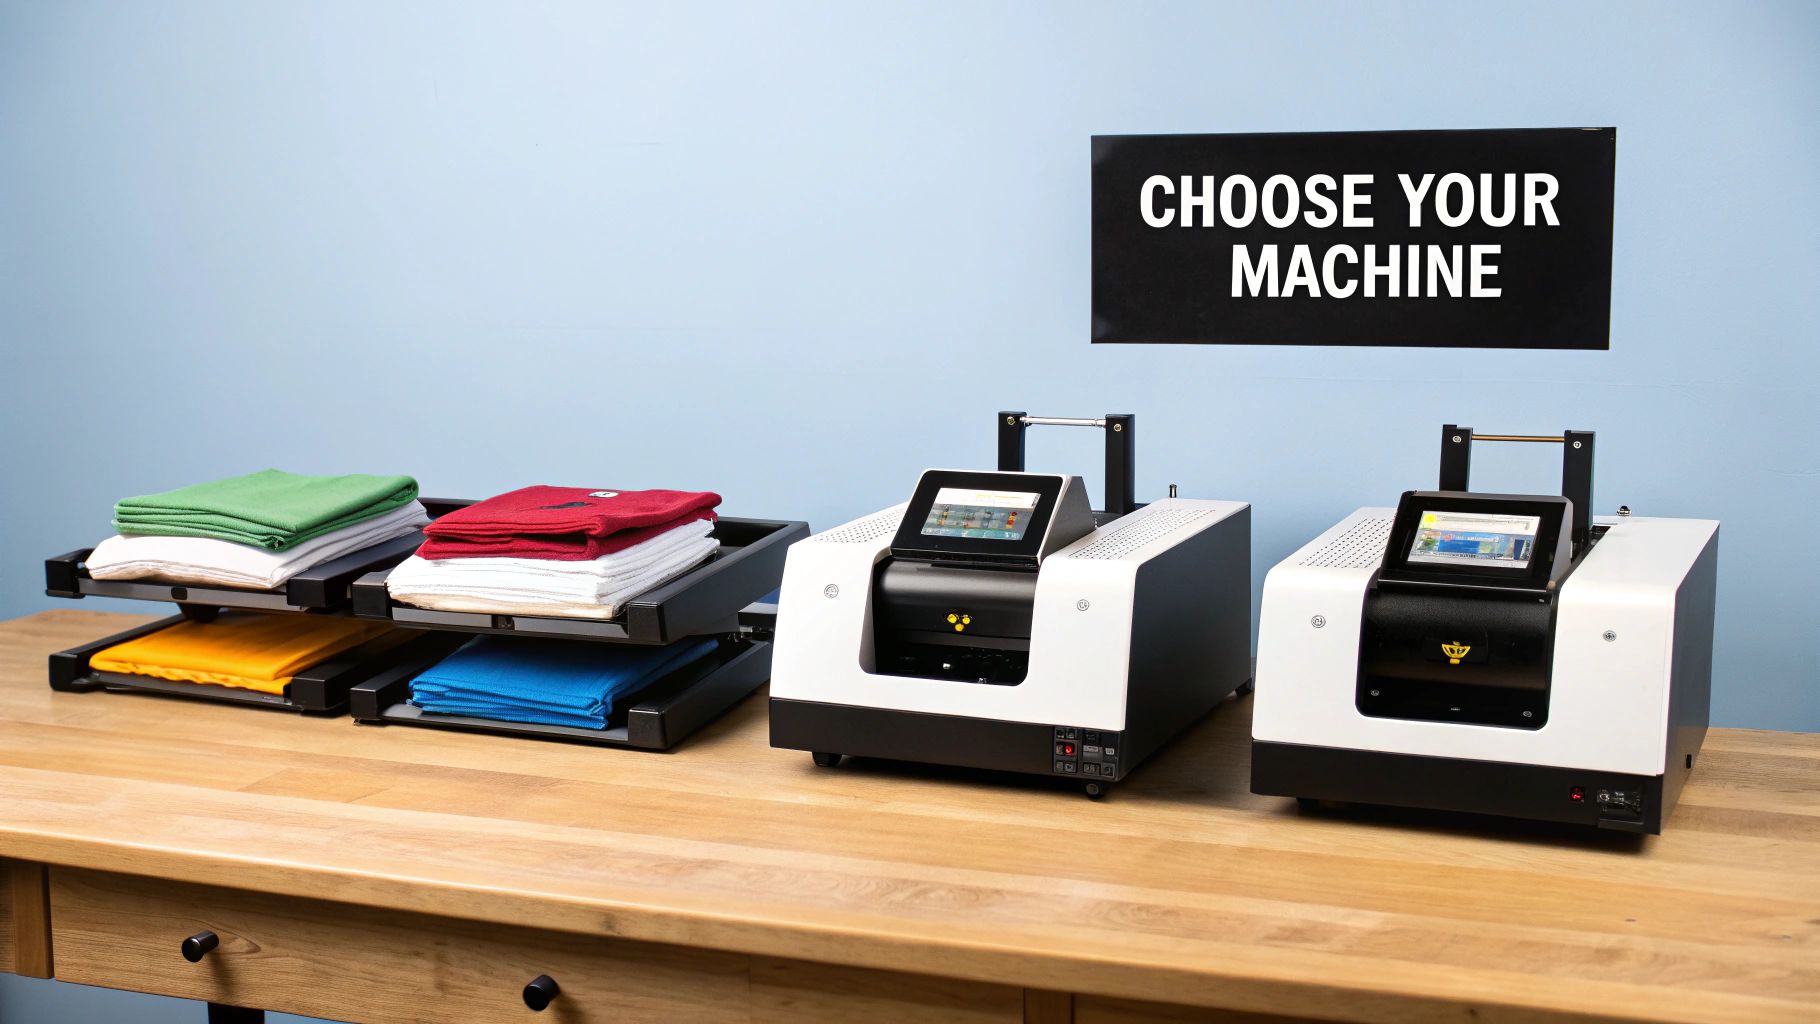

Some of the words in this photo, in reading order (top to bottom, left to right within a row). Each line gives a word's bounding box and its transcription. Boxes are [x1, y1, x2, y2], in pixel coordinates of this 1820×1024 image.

[1140, 173, 1374, 229] CHOOSE
[1397, 172, 1561, 227] YOUR
[1230, 243, 1503, 299] MACHINE
